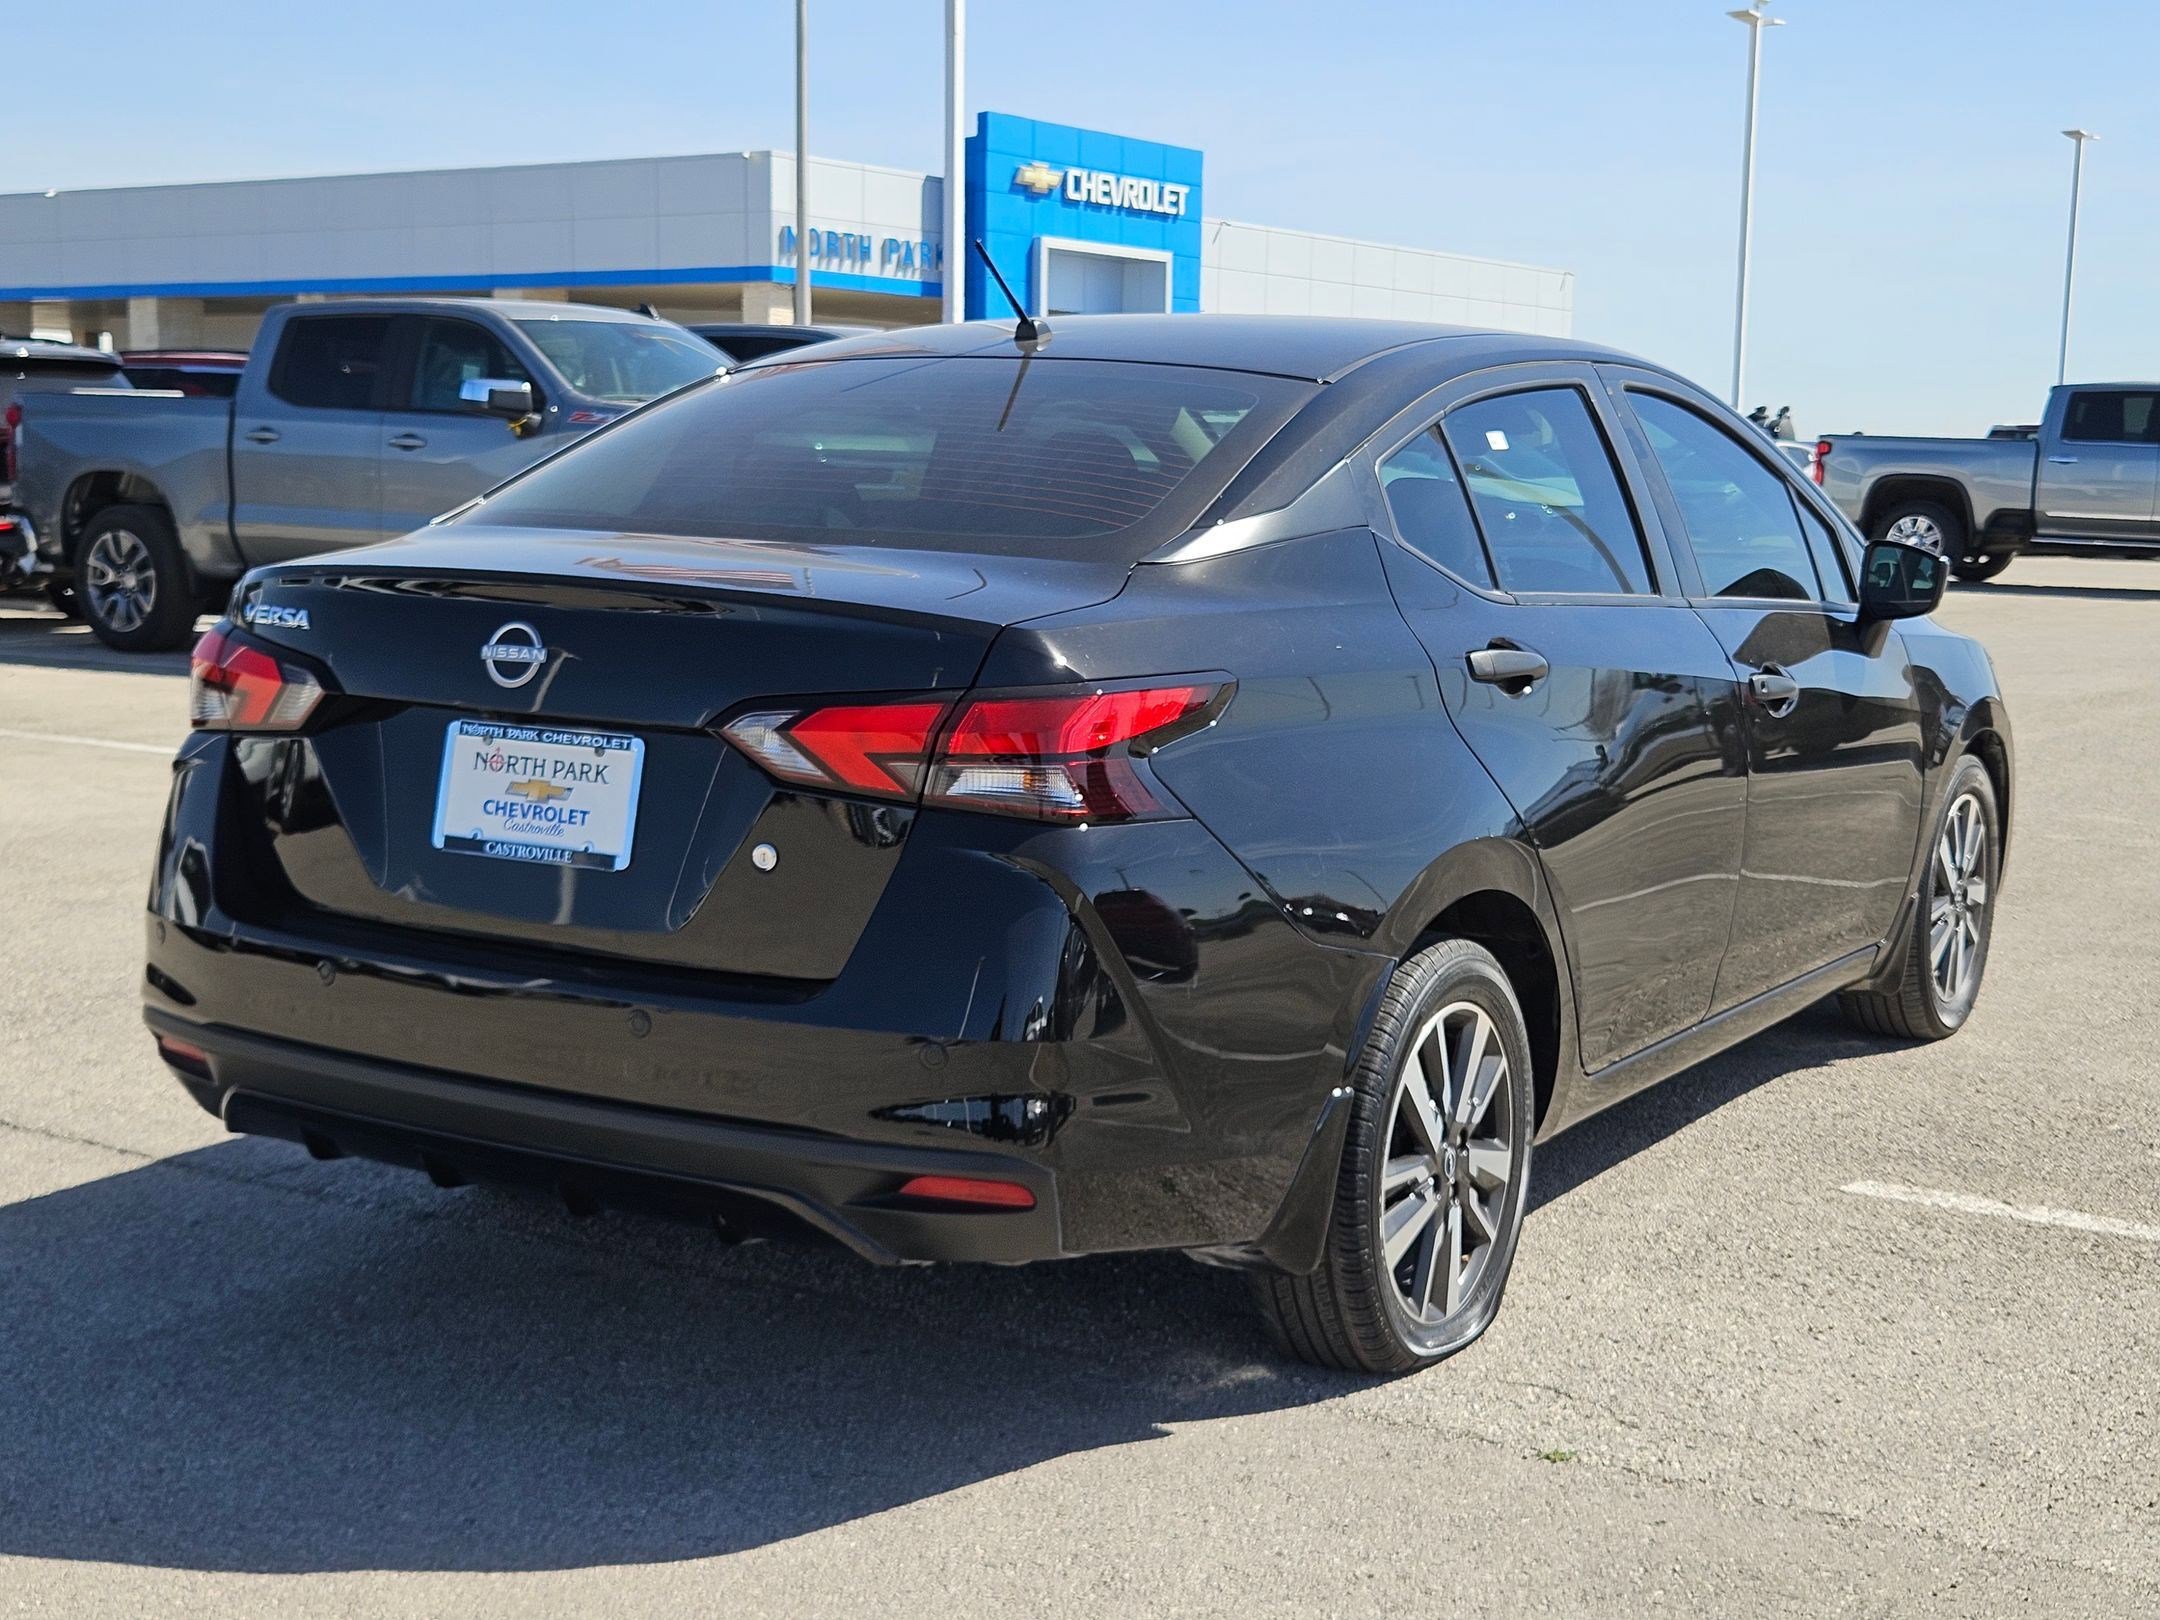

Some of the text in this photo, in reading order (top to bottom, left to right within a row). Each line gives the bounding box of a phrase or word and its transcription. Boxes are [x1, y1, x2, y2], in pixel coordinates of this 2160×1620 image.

[1067, 168, 1189, 216] CHEVROLET
[245, 604, 311, 630] VERSA
[482, 645, 546, 663] NISSAN
[462, 724, 630, 749] NORTH PARK CHEVROLET
[474, 748, 609, 784] NORTH PARK
[483, 799, 590, 825] CHEVROLET
[503, 817, 565, 838] Castroville
[486, 842, 573, 863] CASTROVILLE
